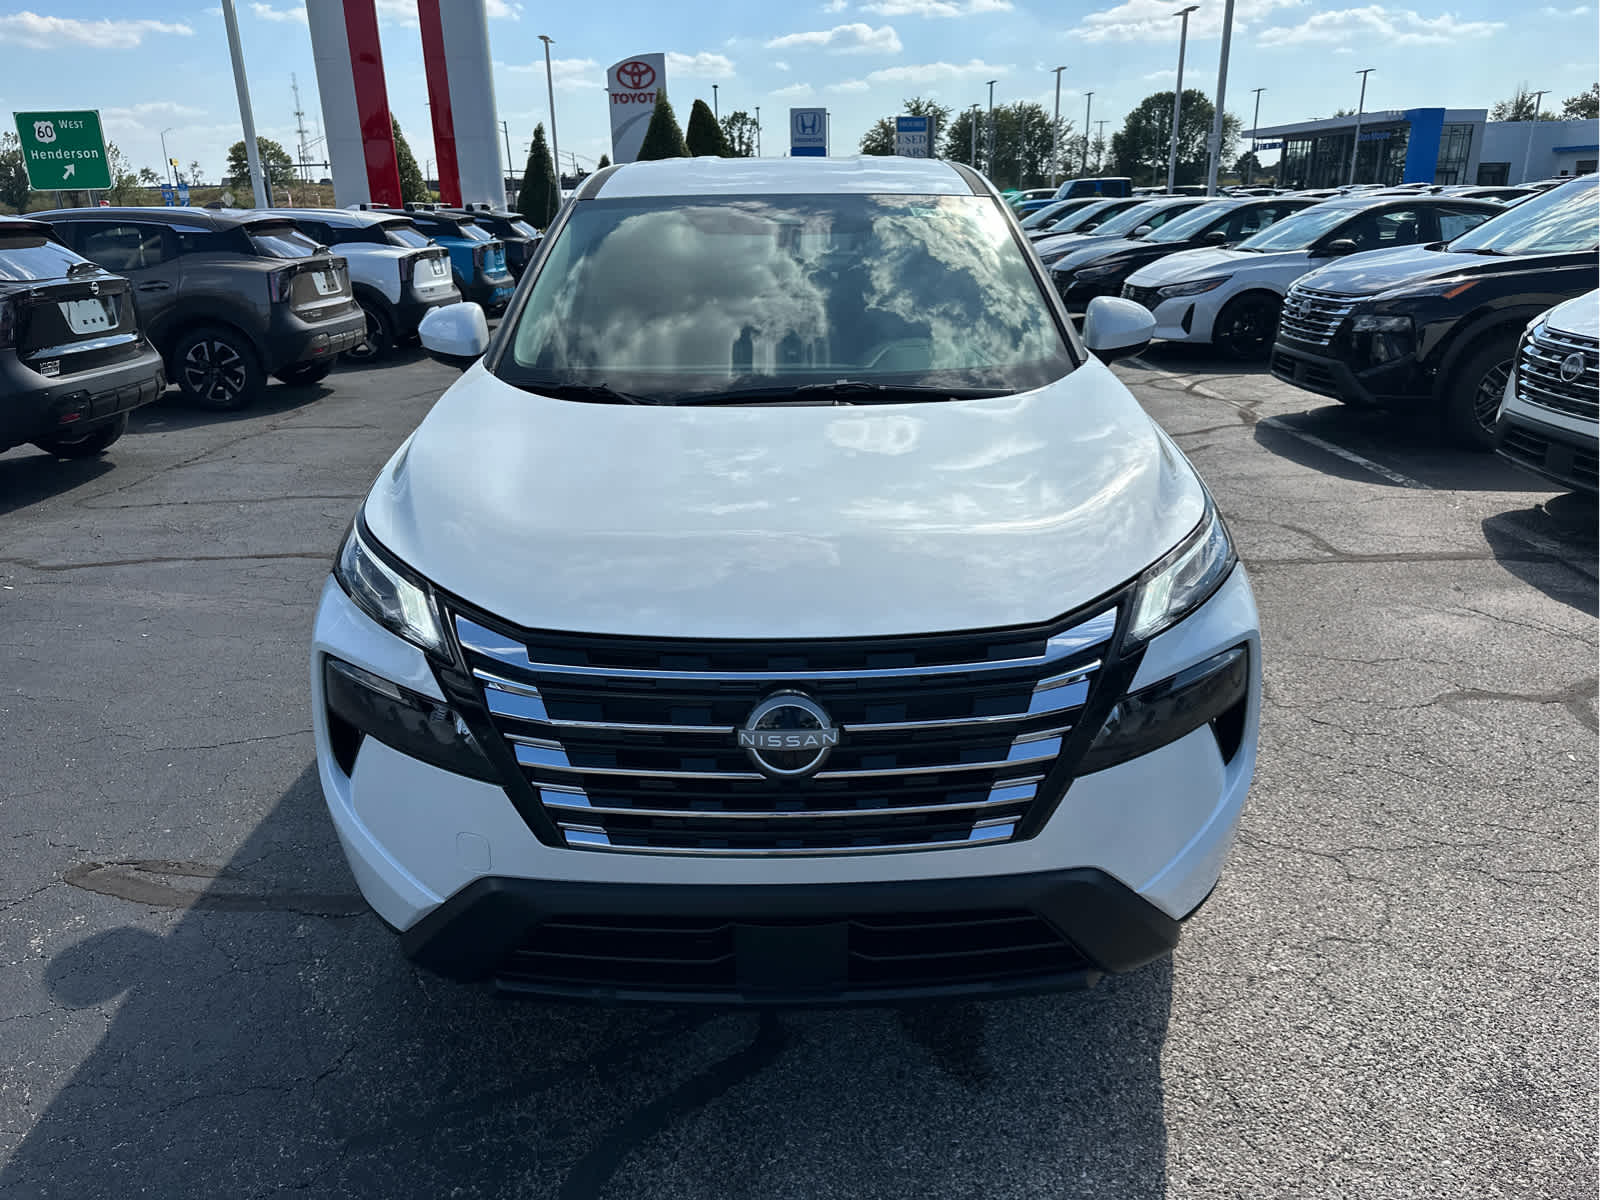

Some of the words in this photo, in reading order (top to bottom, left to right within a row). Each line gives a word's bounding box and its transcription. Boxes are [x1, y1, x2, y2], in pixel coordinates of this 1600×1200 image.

[611, 92, 657, 105] TOYOT
[37, 126, 53, 138] 60
[897, 134, 927, 145] USED
[30, 148, 99, 160] Henderson
[897, 147, 927, 157] CARS
[740, 731, 837, 748] NISSAN
